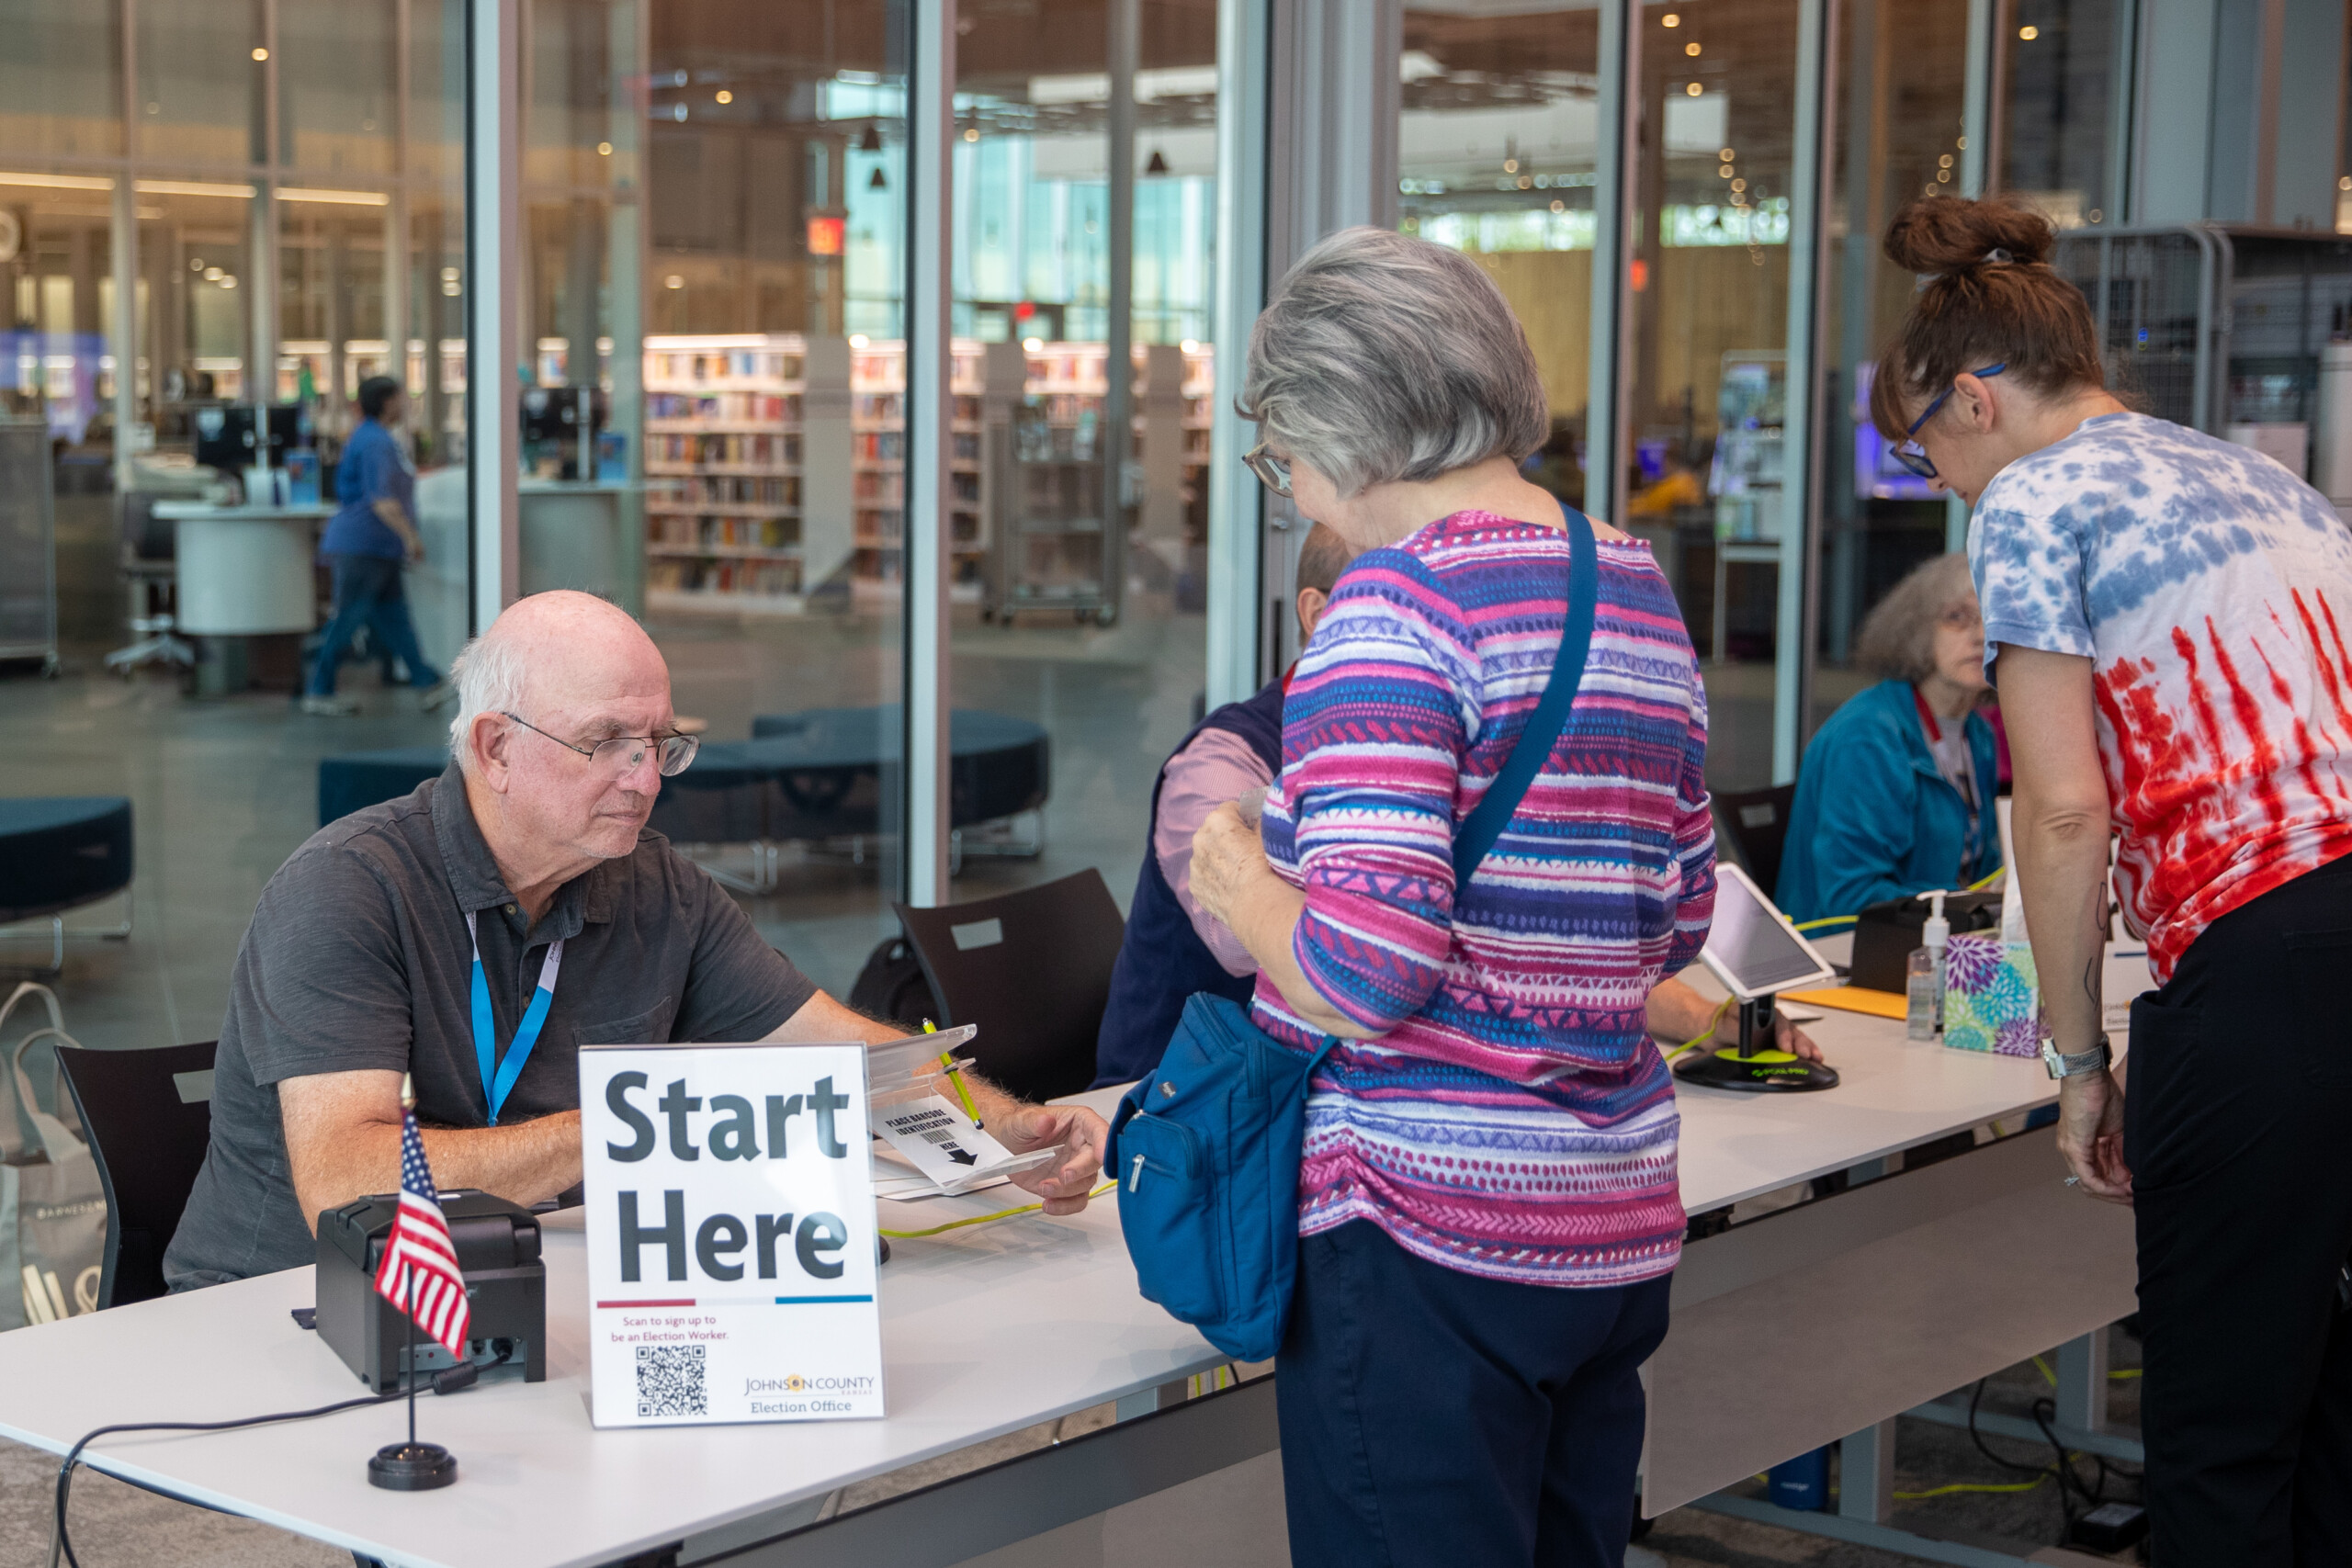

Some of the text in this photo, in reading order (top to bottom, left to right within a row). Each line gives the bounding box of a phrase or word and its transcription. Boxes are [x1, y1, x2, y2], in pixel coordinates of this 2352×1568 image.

[605, 1070, 850, 1163] Start
[885, 1109, 946, 1127] PLACE BARCODE
[895, 1117, 956, 1135] IDENTIFICATION
[939, 1141, 959, 1150] HERE
[37, 1204, 85, 1220] BARNES
[617, 1189, 848, 1283] Here
[623, 1316, 717, 1328] Scan to sign up to
[611, 1332, 625, 1342] be
[643, 1330, 685, 1341] Election
[688, 1329, 729, 1340] Worker.
[816, 1377, 875, 1390] COUNTY
[751, 1399, 853, 1414] Election Office
